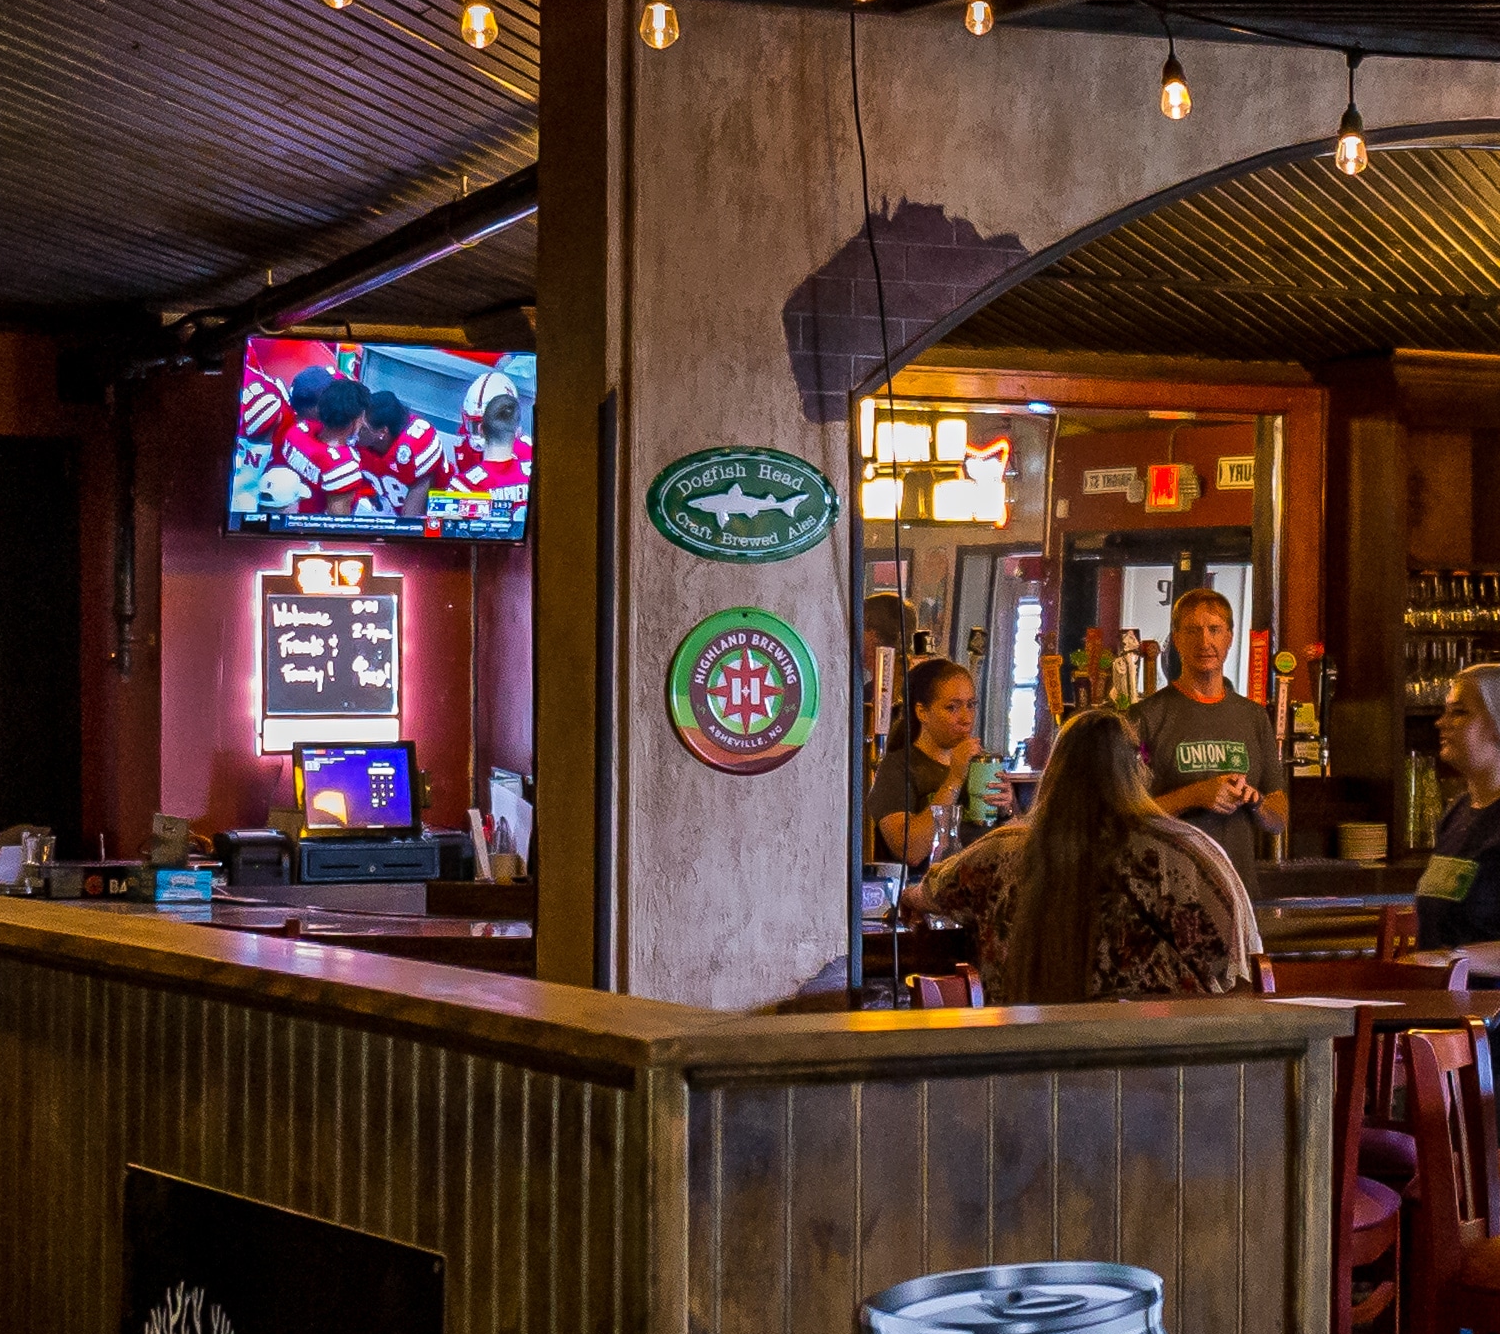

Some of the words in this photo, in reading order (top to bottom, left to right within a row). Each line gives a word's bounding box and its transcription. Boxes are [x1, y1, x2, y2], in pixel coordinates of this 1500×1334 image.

[676, 463, 747, 497] Dogfish
[758, 464, 804, 490] Head
[675, 512, 712, 540] Craft
[721, 532, 780, 547] Brewed
[788, 515, 817, 539] Ales
[694, 633, 747, 684] HIGHLAND
[751, 634, 797, 684] BREWING
[708, 725, 768, 747] ASHEVILLE,
[769, 725, 783, 739] NC
[1180, 744, 1226, 763] UNION
